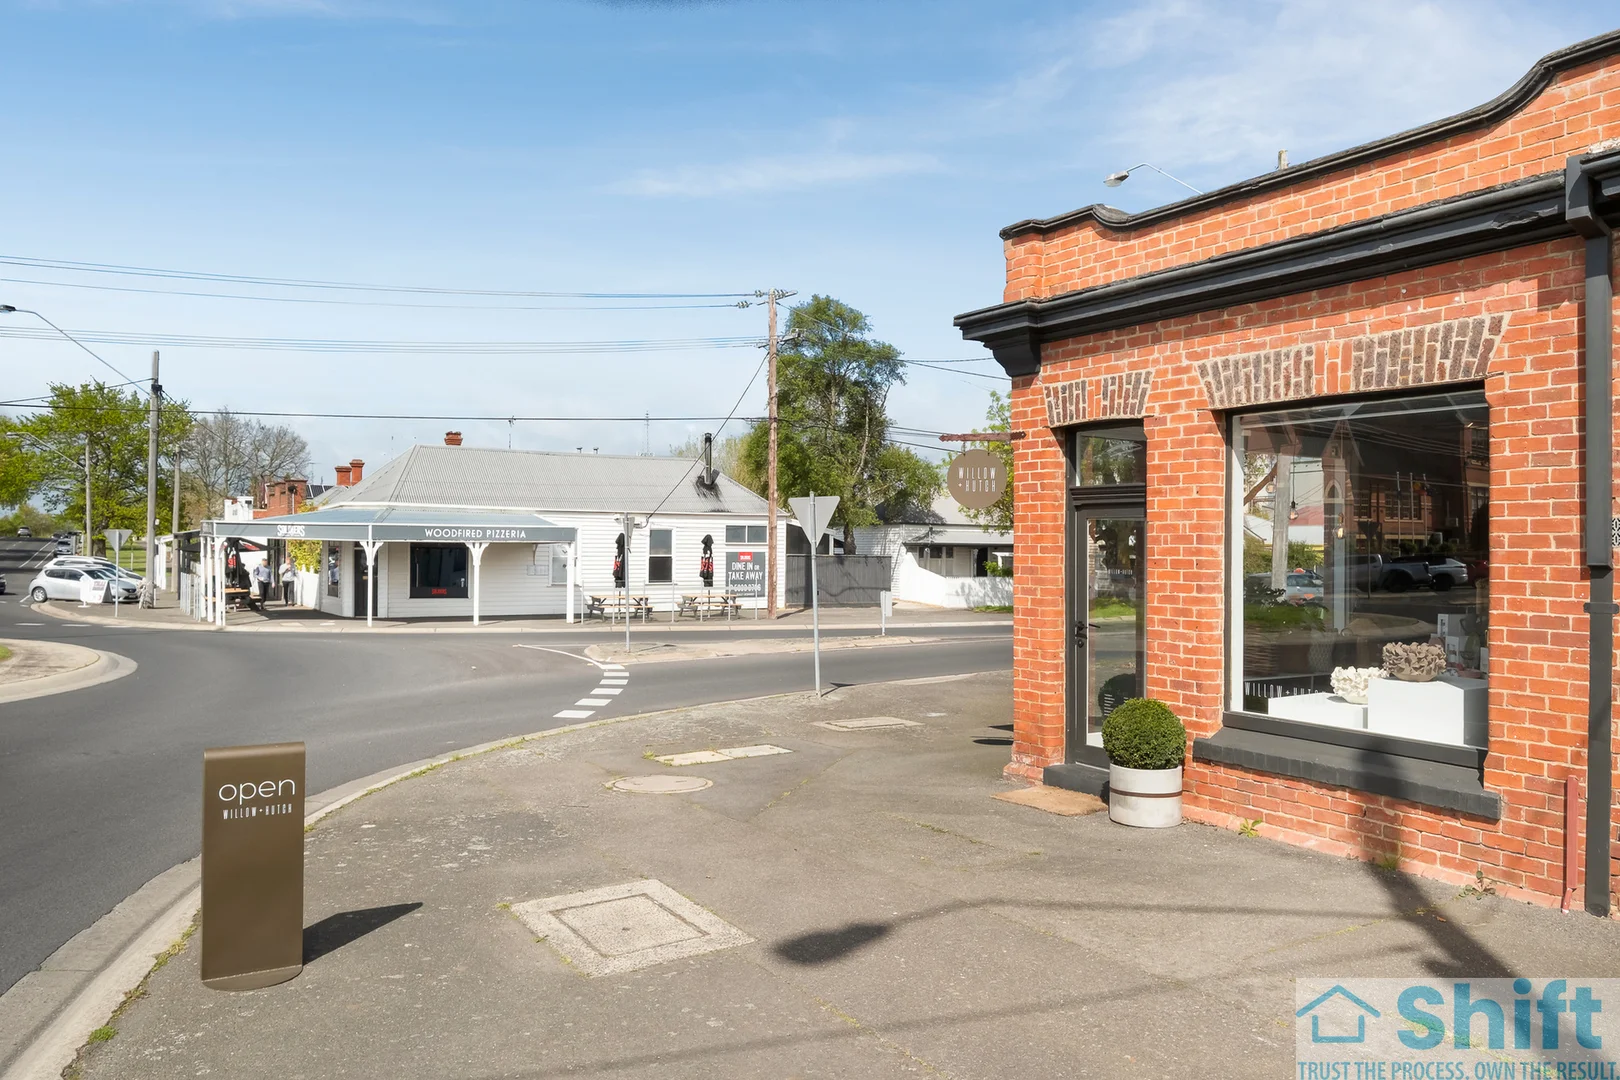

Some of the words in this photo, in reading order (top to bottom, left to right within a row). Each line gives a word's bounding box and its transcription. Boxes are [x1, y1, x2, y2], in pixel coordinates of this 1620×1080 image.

[958, 467, 996, 479] WILLOW
[965, 480, 996, 492] HUTCH
[425, 528, 483, 538] WOODFIRED
[486, 529, 526, 539] PIZZERIA
[732, 562, 745, 570] DINE
[746, 562, 753, 570] IN
[728, 571, 744, 580] TAKE
[745, 571, 763, 580] AWAY
[1244, 682, 1283, 699] WILLOW
[218, 779, 296, 805] open
[222, 807, 257, 820] WILLOW
[265, 803, 292, 816] HUTCH
